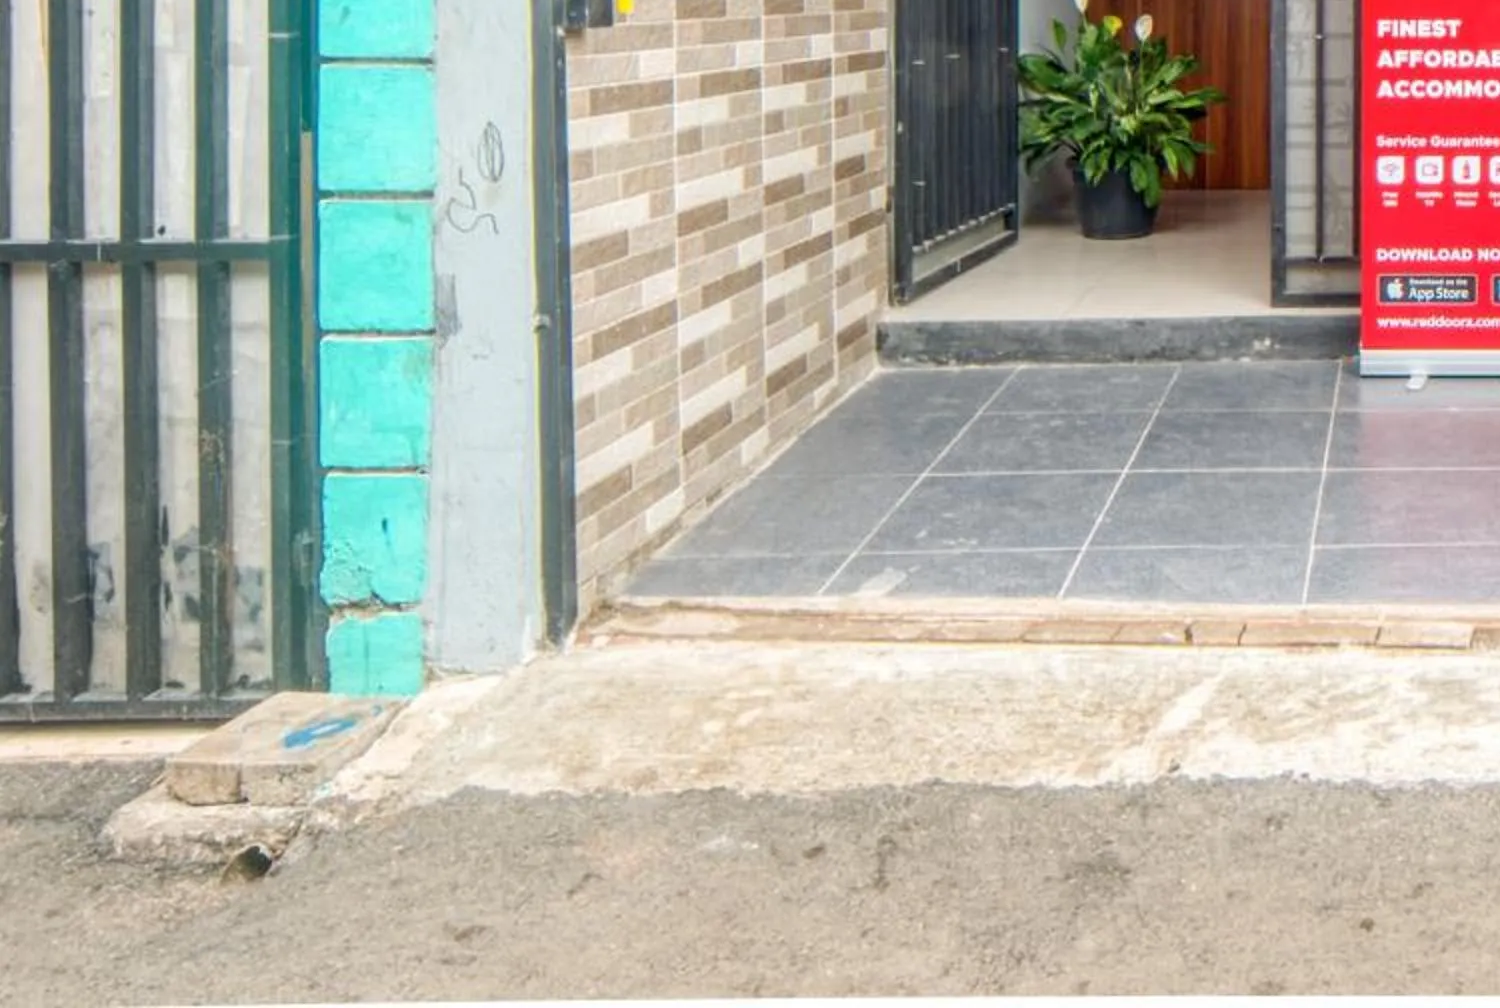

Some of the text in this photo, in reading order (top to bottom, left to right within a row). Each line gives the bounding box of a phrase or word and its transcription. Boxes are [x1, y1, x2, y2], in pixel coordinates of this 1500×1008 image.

[1376, 19, 1462, 39] FINEST
[1376, 134, 1428, 149] Service
[1376, 247, 1473, 262] DOWNLOAD
[1408, 286, 1469, 302] App Store
